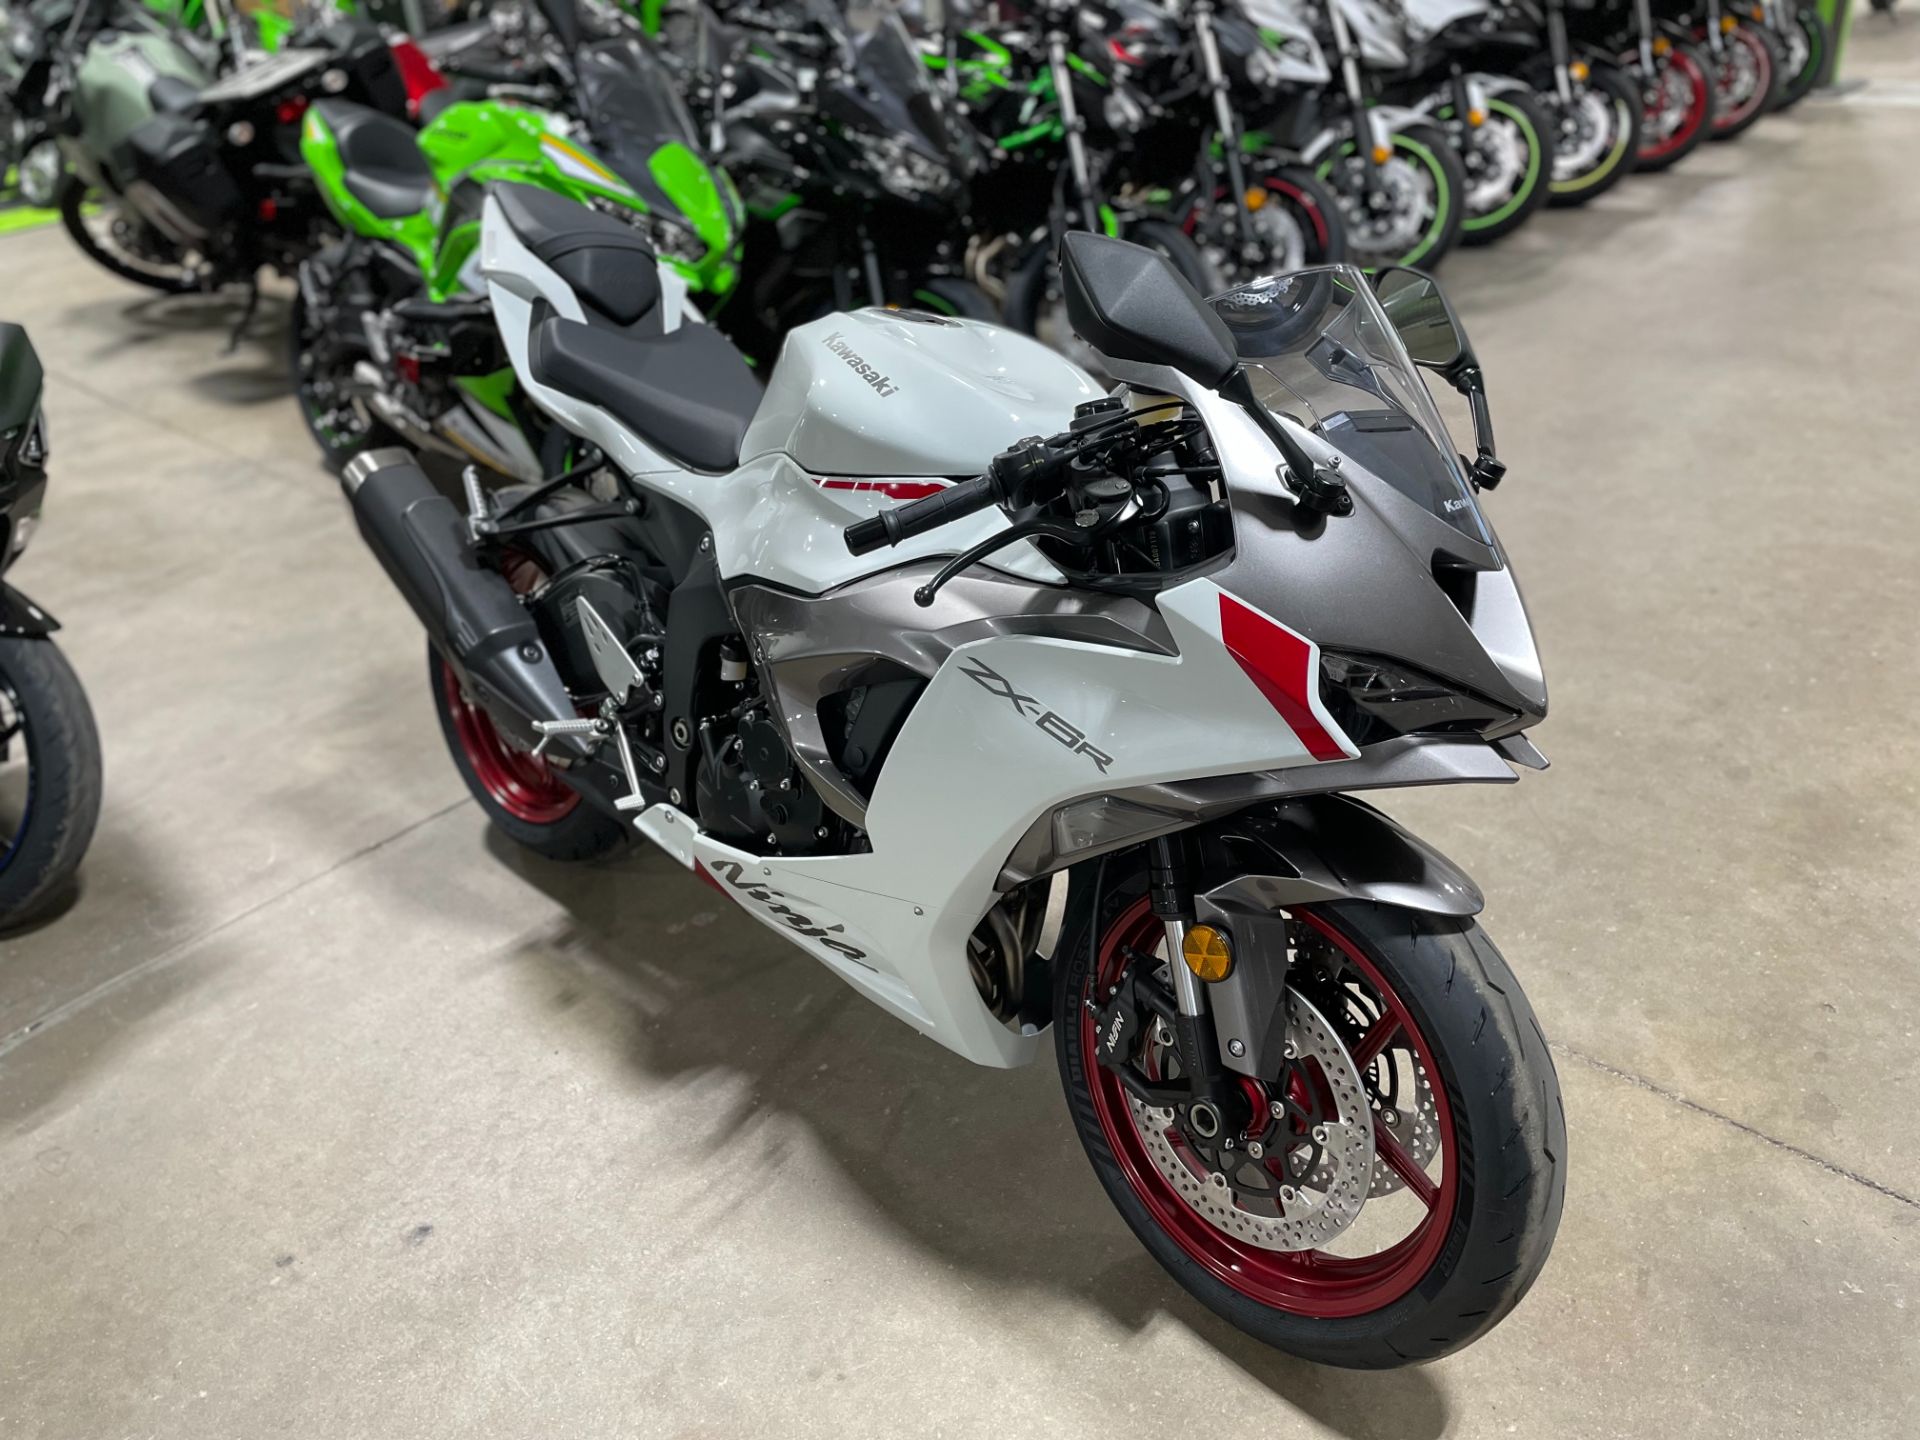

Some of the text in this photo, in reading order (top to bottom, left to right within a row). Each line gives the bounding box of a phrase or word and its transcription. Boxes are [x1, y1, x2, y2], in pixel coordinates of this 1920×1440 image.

[822, 331, 900, 398] Kawasaki
[957, 655, 1114, 775] ZX-6R
[711, 861, 879, 973] Ninja
[1066, 994, 1083, 1081] DIABLO
